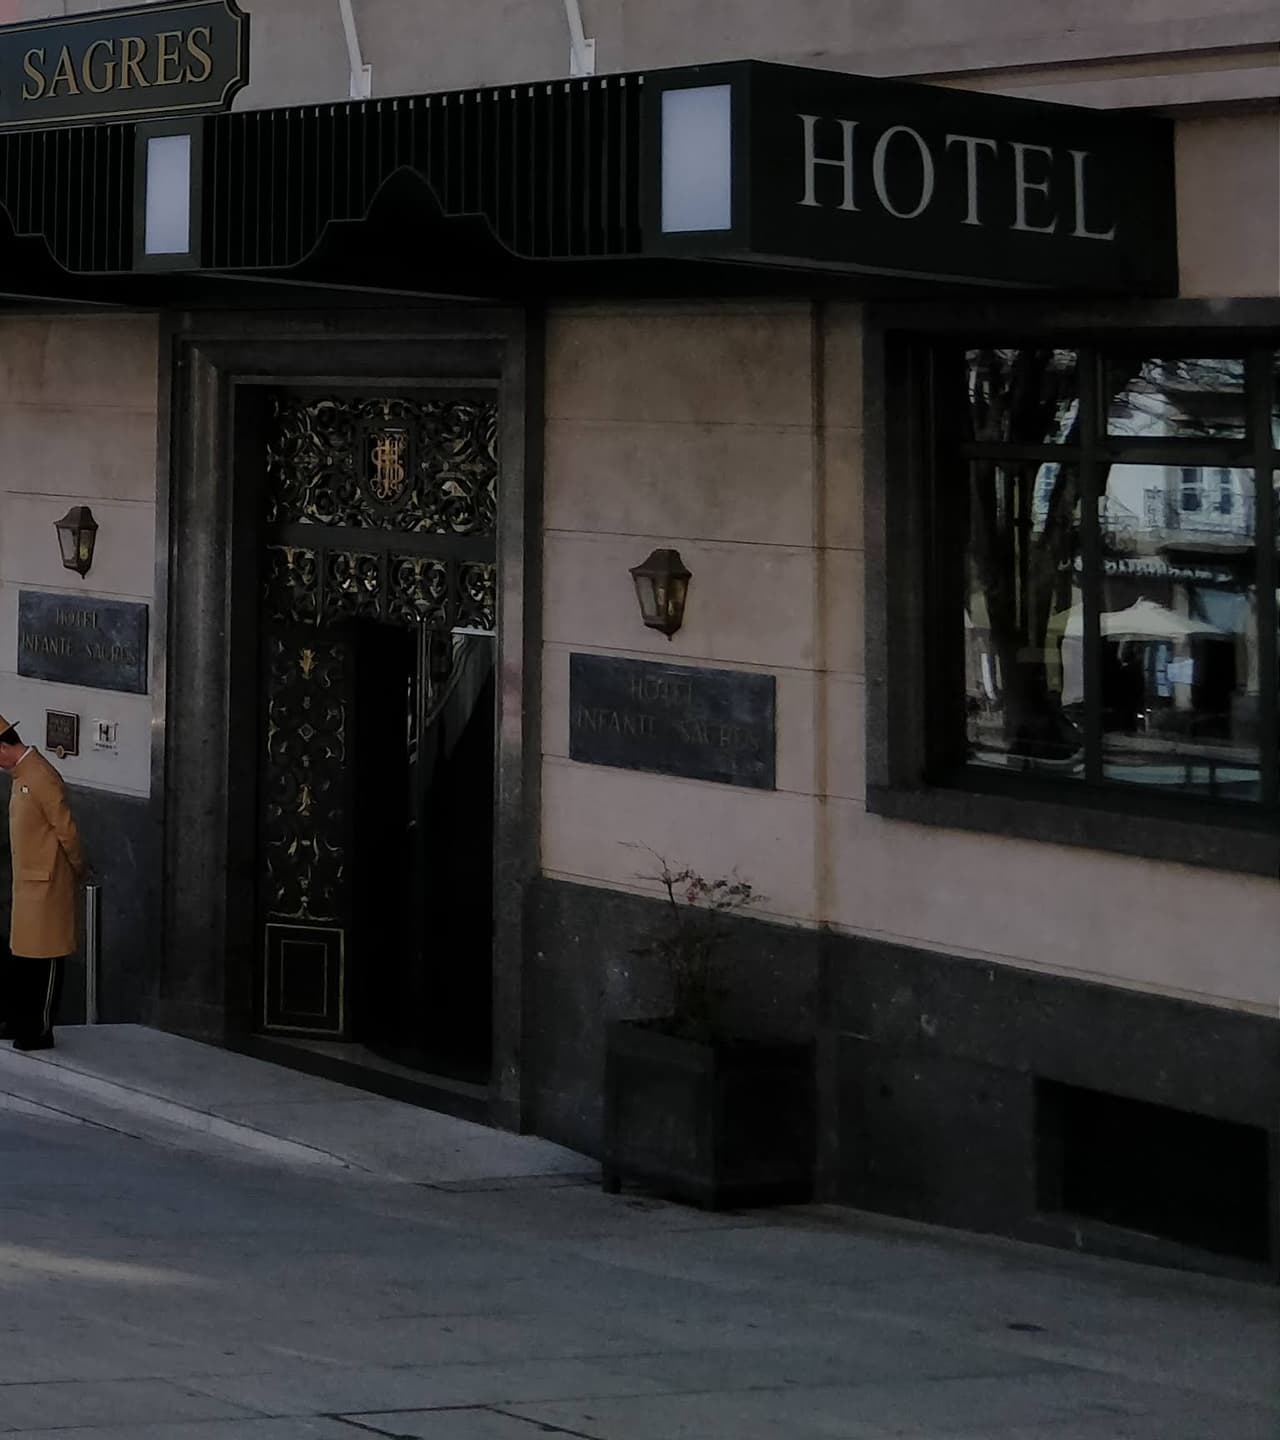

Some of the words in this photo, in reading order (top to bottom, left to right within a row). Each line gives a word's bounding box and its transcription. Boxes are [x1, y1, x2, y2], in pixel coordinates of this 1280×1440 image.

[22, 26, 213, 101] SAGRES
[795, 114, 1117, 241] HOTEL
[22, 631, 73, 657] INFANTE
